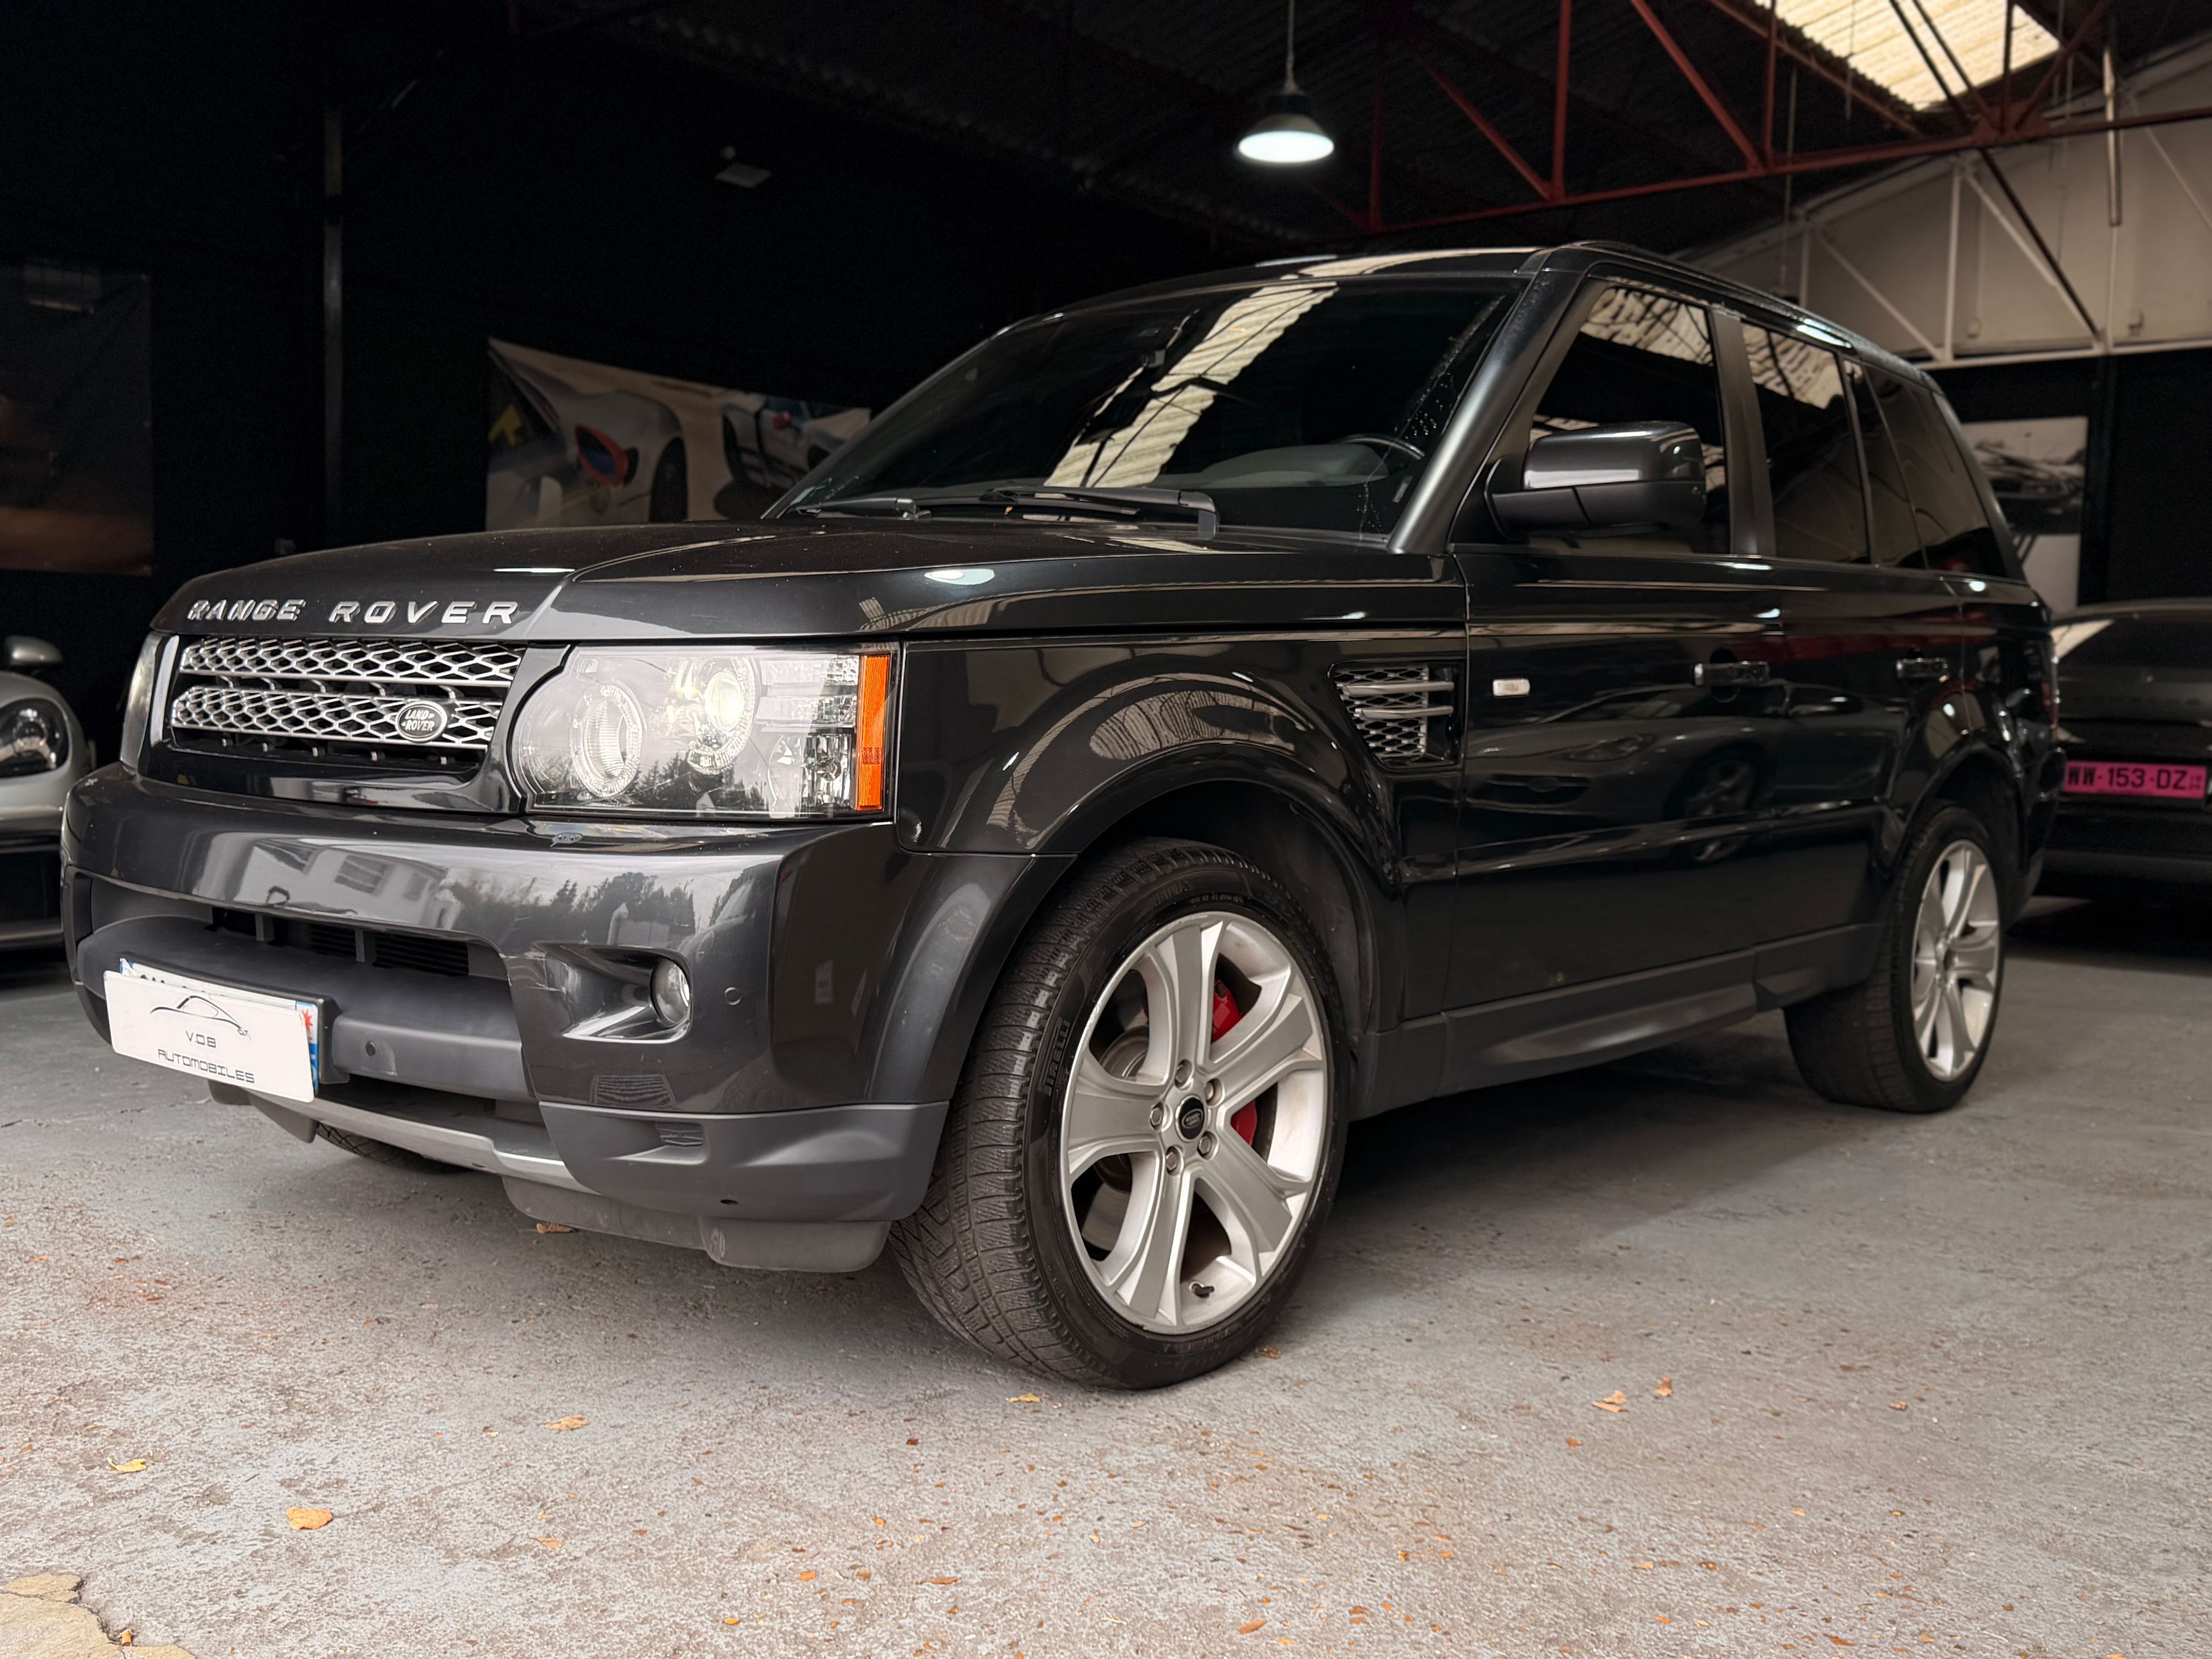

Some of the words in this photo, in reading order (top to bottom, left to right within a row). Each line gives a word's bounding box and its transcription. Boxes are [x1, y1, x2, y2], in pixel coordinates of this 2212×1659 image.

[187, 599, 307, 621] RANGE
[329, 601, 517, 624] ROVER
[405, 709, 430, 720] LAND
[405, 719, 435, 731] ROVER
[158, 1049, 254, 1083] AUTOMOBILES
